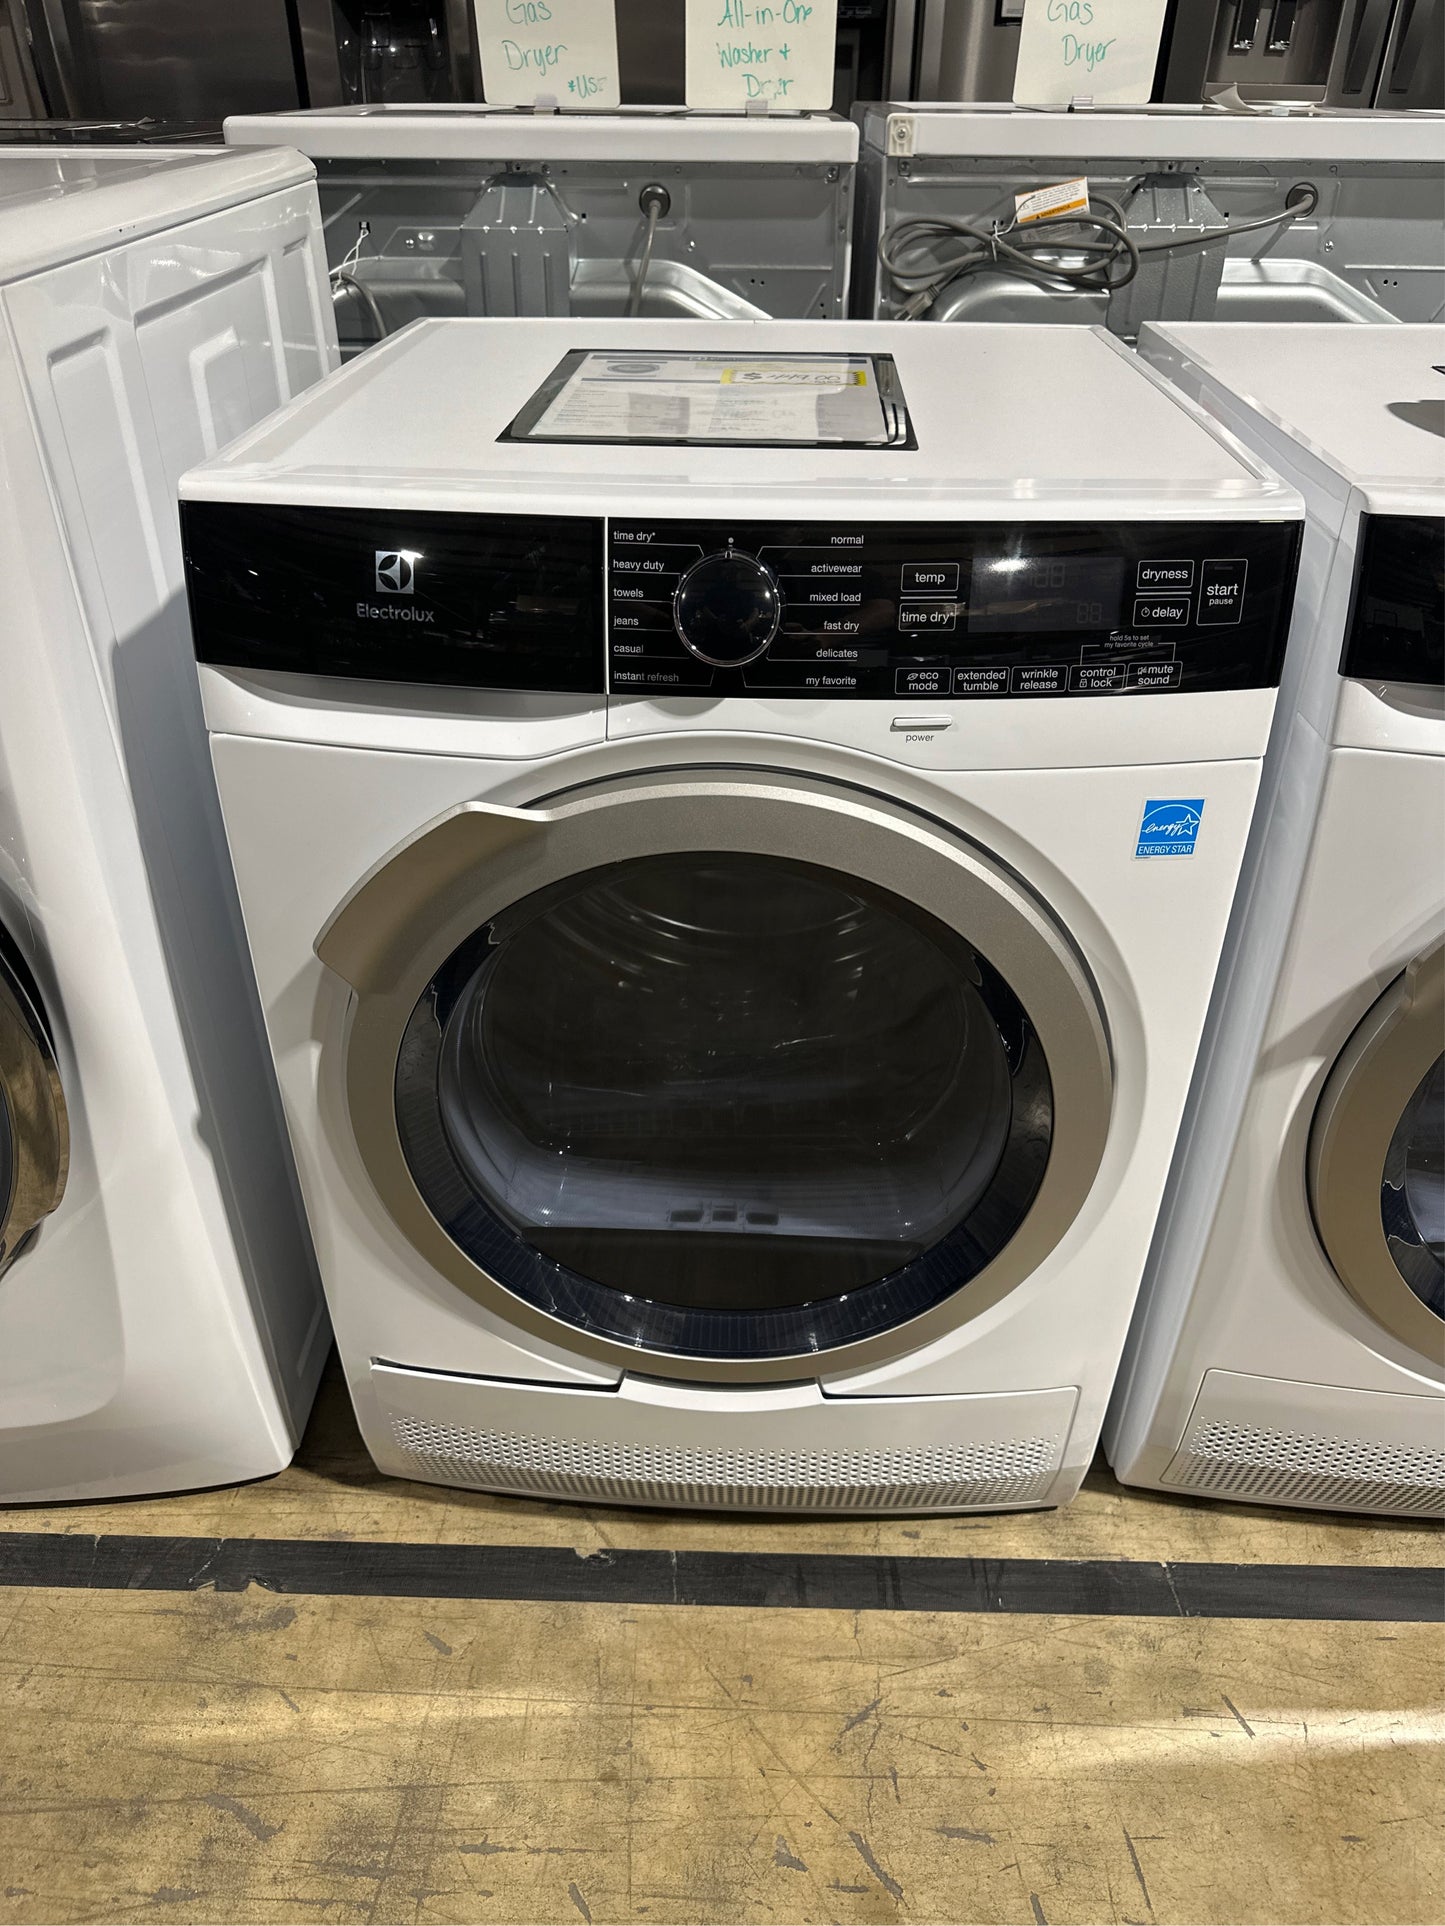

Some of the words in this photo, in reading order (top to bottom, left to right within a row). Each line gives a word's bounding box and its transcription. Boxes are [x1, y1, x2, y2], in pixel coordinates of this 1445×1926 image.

[505, 0, 552, 25] Gas
[1047, 0, 1094, 25] Gas
[501, 40, 568, 76] Dryer
[716, 42, 773, 68] Washer
[1061, 34, 1117, 72] Dryer
[742, 74, 794, 98] Drr
[613, 531, 634, 540] time
[831, 535, 864, 545] normal
[613, 559, 641, 571] heavy
[643, 560, 664, 572] duty
[810, 564, 862, 573] activewear
[915, 572, 946, 585] temp
[1142, 569, 1188, 581] dryness
[613, 588, 644, 598] towels
[1206, 583, 1239, 596] start
[809, 592, 838, 602] mixed
[840, 592, 861, 602] load
[1209, 598, 1233, 606] pause
[356, 602, 435, 622] Electrolux
[1152, 607, 1183, 619] delay
[613, 617, 639, 626] jeans
[902, 612, 927, 622] time
[930, 612, 950, 624] dry
[823, 621, 841, 630] fast
[843, 622, 860, 632] dry
[613, 644, 644, 653] casual
[816, 649, 858, 658] delicates
[1021, 669, 1058, 679] wrinkle
[1080, 667, 1116, 677] control
[1148, 665, 1174, 674] mute
[613, 671, 645, 681] instant
[647, 672, 679, 682] refresh
[919, 672, 939, 680] eco
[957, 670, 1006, 680] extended
[1137, 675, 1170, 685] sound
[806, 678, 819, 687] my
[822, 676, 857, 686] favorite
[908, 681, 938, 691] mode
[963, 680, 999, 691] tumble
[1020, 680, 1058, 689] release
[1091, 678, 1112, 687] lock
[905, 734, 934, 743] power
[1138, 845, 1171, 854] ENERGY
[1171, 844, 1193, 853] STAR
